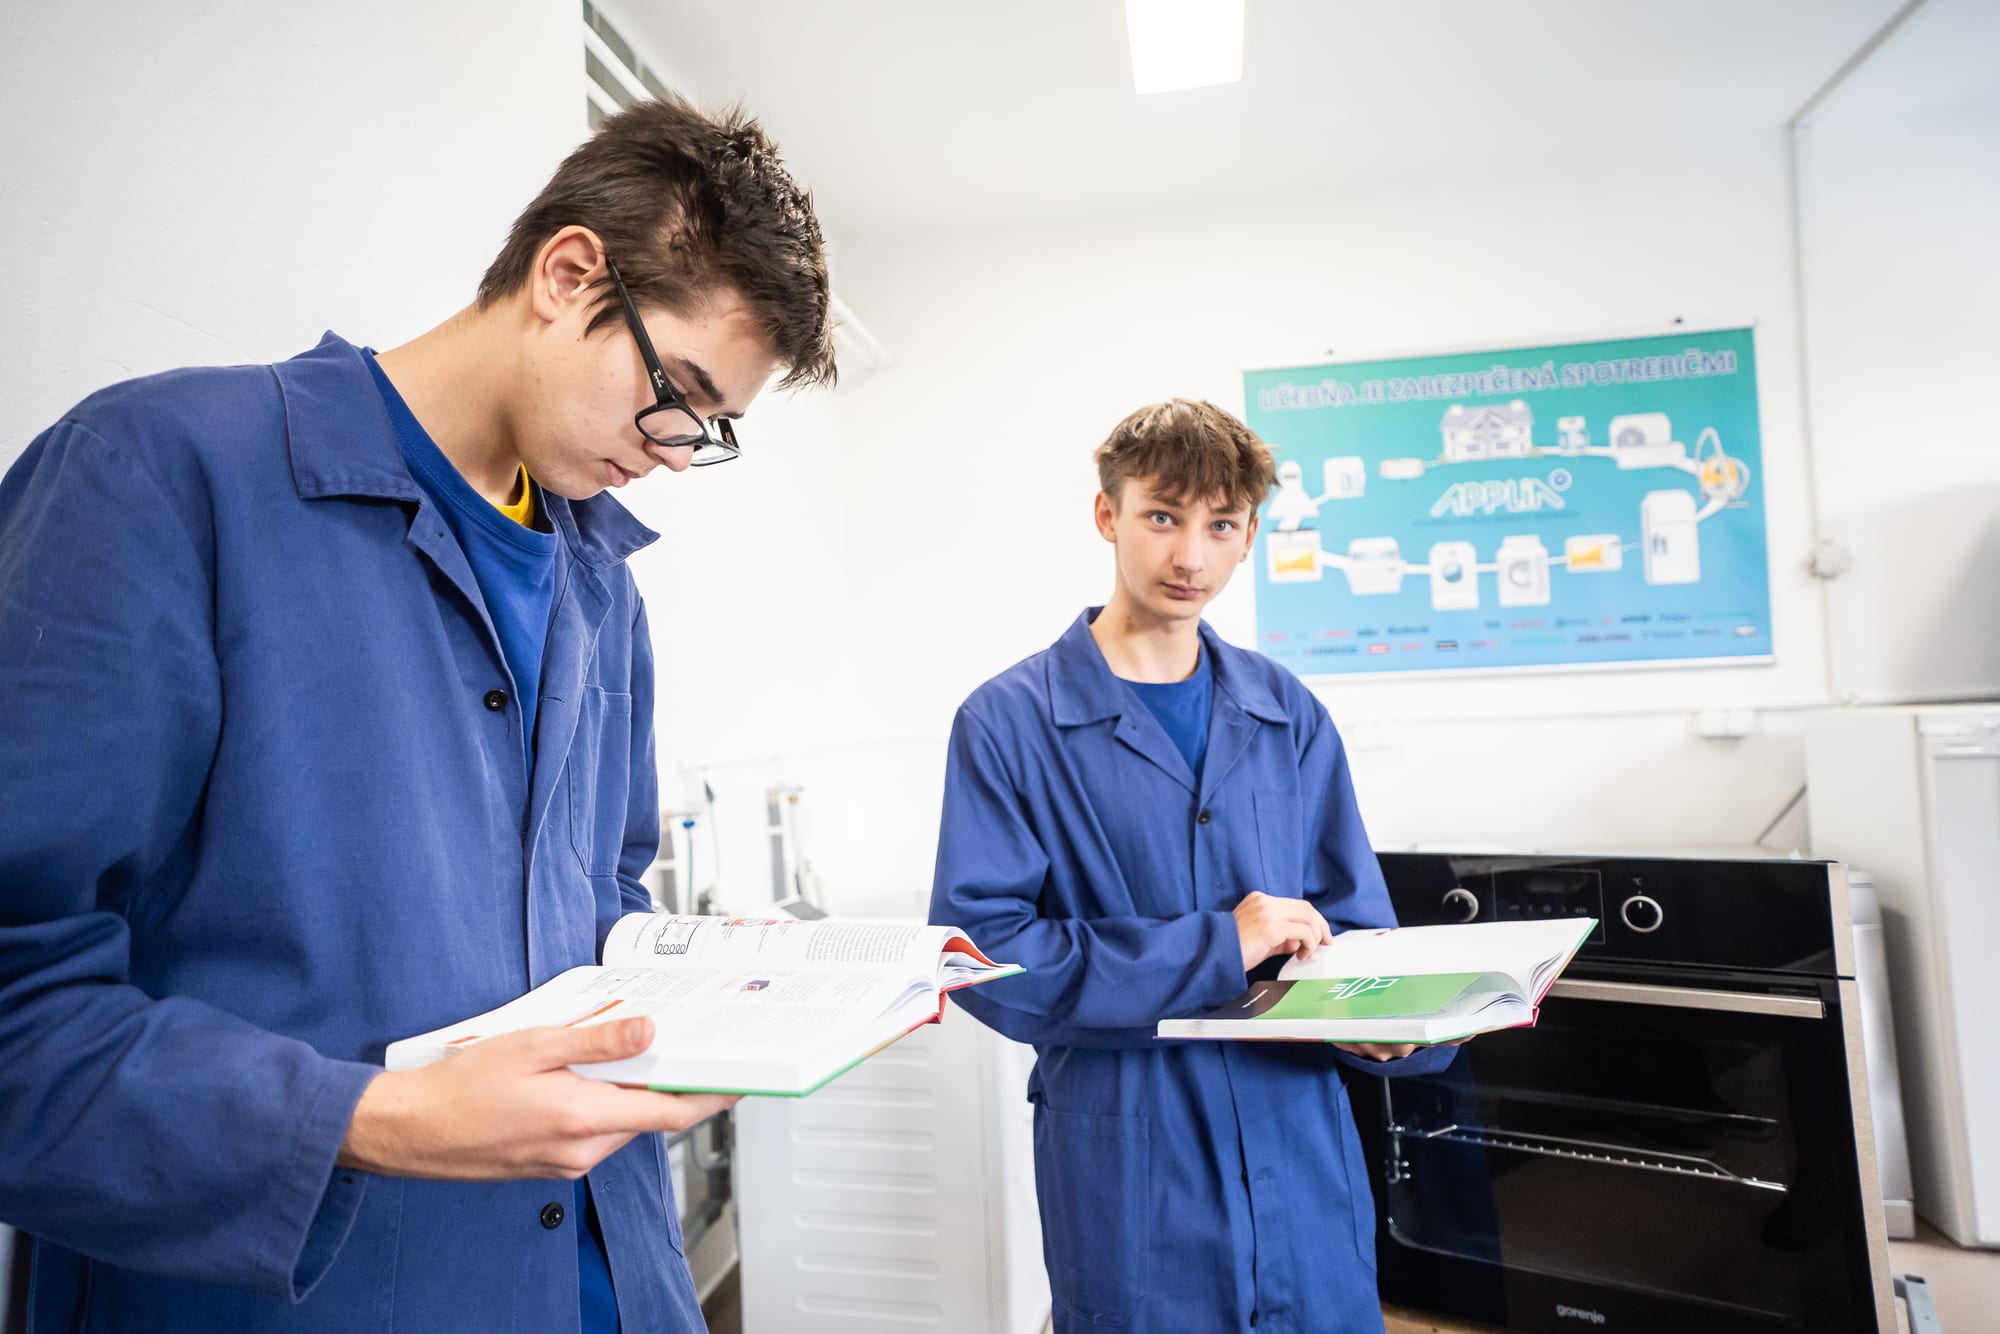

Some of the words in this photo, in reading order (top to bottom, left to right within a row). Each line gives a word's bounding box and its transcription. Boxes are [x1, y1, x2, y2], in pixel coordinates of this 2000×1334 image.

[1361, 380, 1385, 404] JE
[1561, 347, 1738, 388] SPOTREBIČMI
[1556, 1304, 1605, 1324] gorenje
